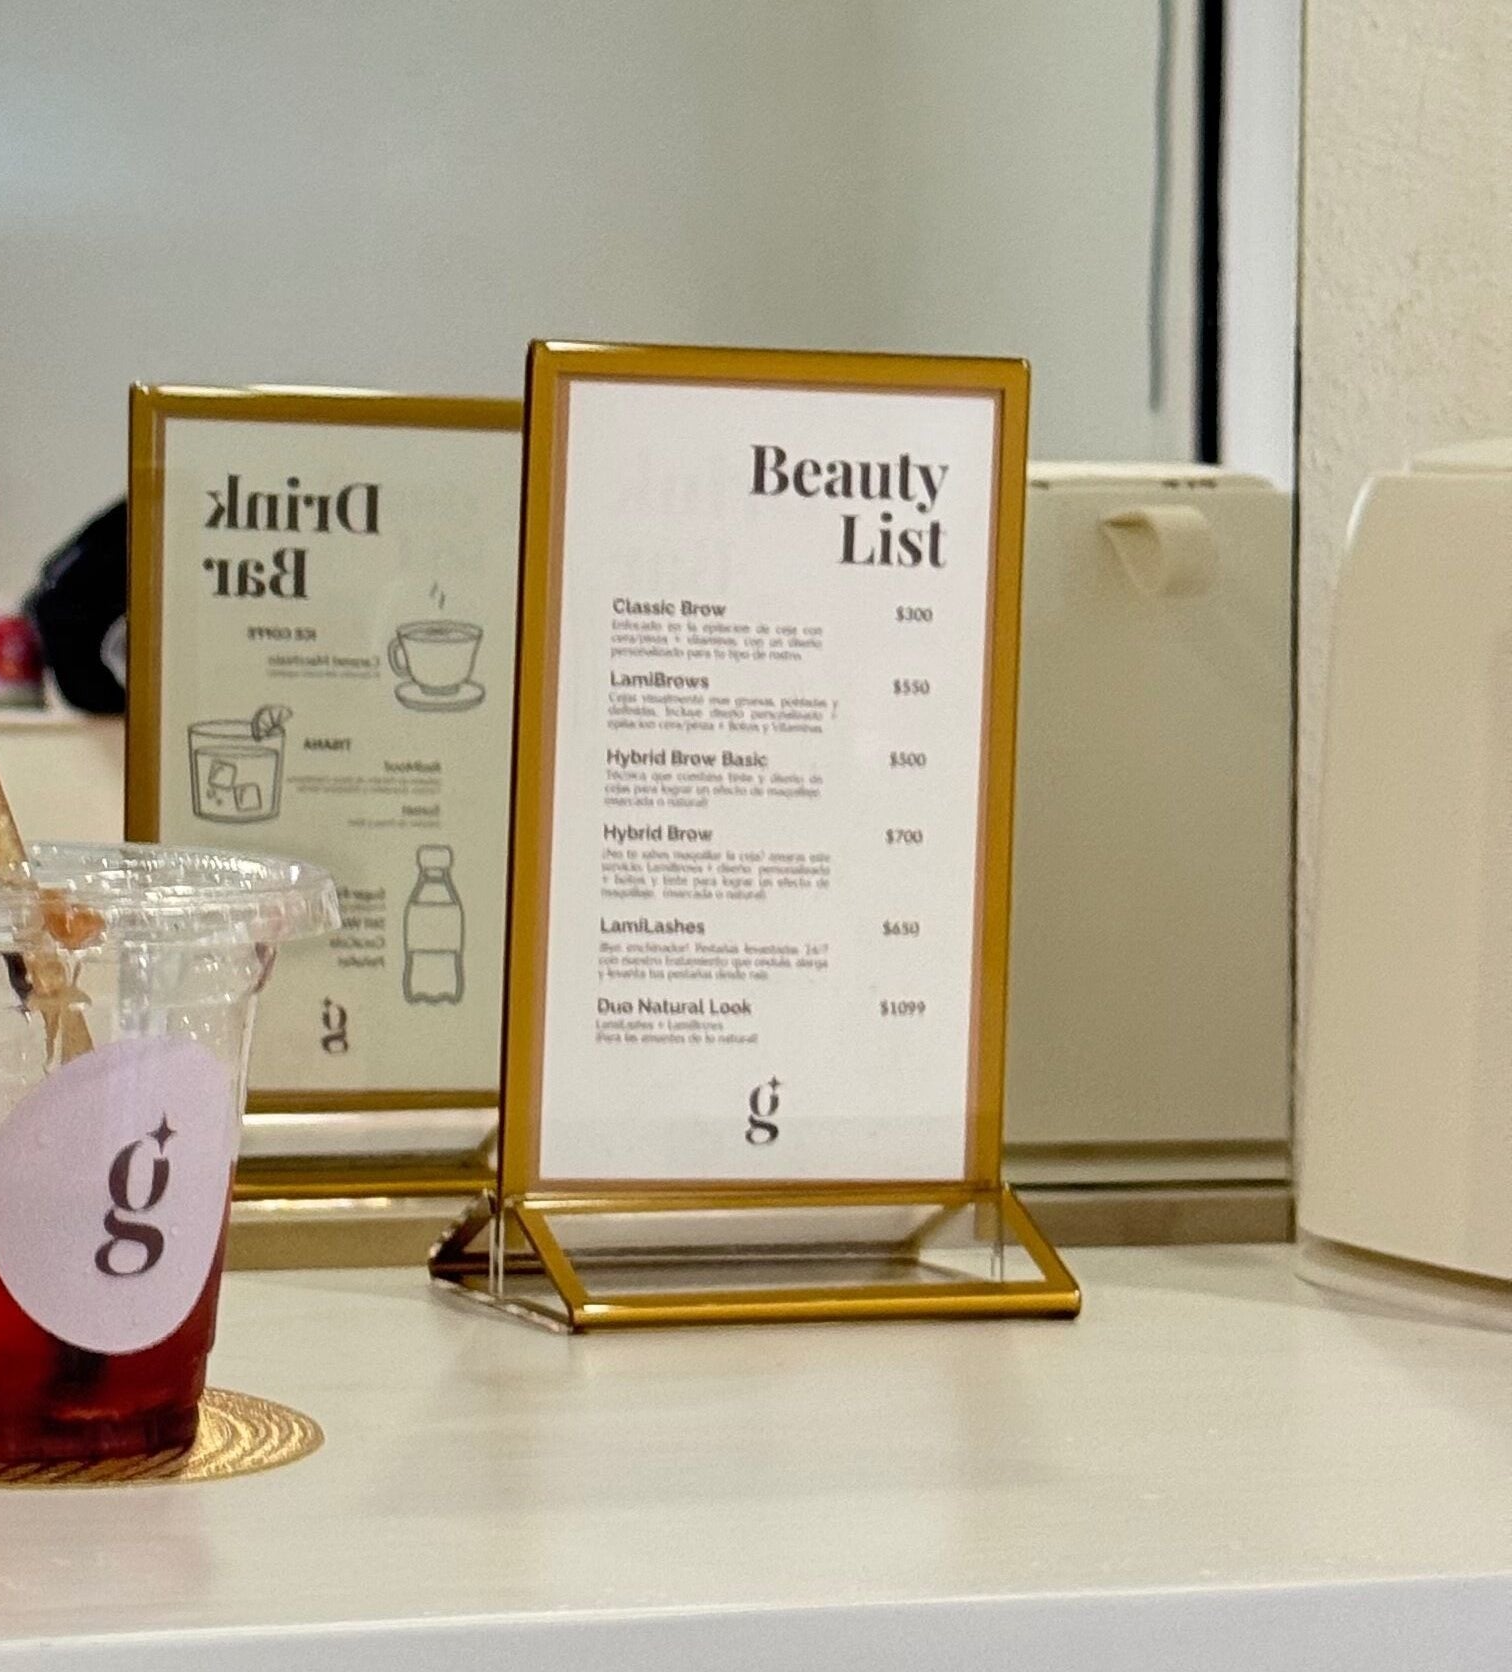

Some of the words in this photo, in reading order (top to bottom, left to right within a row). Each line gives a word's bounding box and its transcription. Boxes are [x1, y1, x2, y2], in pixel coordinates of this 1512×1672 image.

[749, 443, 950, 514] Beauty
[838, 511, 948, 569] List
[612, 598, 675, 616] Classic
[681, 600, 727, 617] Brow
[895, 605, 934, 623] $300
[610, 670, 709, 689] LamiBrows
[893, 678, 929, 695] $550
[606, 748, 666, 768] Hybrid
[671, 750, 716, 767] Brow
[722, 751, 768, 767] Basic
[890, 752, 926, 768] $500
[603, 823, 663, 844] Hybrid
[668, 825, 713, 842] Brow
[886, 829, 923, 845] $700
[600, 917, 705, 935] LamiLashes
[597, 998, 633, 1014] Duo
[638, 998, 705, 1015] Natural
[710, 998, 752, 1015] Look
[881, 1001, 926, 1017] $1099
[95, 1112, 176, 1277] g
